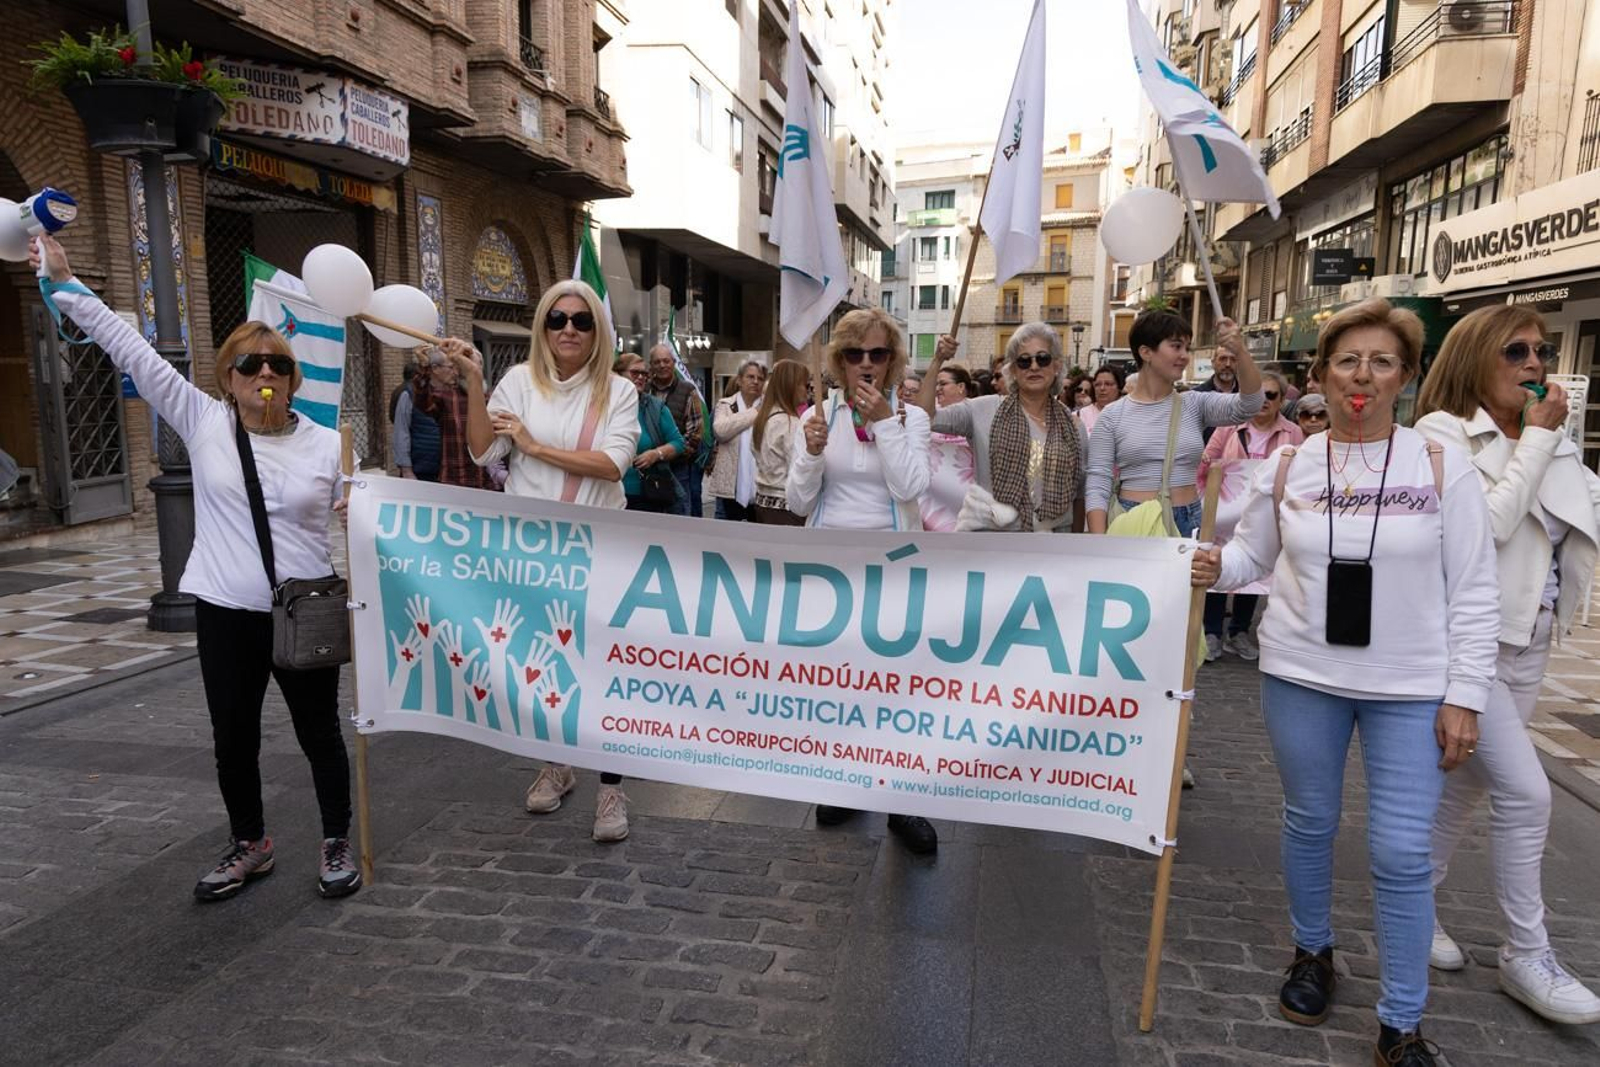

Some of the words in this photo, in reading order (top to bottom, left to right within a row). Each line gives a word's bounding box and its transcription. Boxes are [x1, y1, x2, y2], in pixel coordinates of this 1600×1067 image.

[350, 87, 389, 113] PELUQUERIA
[350, 102, 391, 128] CABALLEROS
[351, 119, 406, 157] TOLEDANO
[1515, 287, 1570, 304] MANGASVERDES
[375, 503, 593, 558] JUSTICIA
[420, 554, 442, 578] la
[452, 553, 590, 591] SANIDAD
[608, 543, 1151, 682] ANDÚJAR
[606, 643, 769, 680] ASOCIACIÓN
[777, 662, 901, 695] ANDÚJAR
[909, 674, 963, 702] POR
[970, 681, 1002, 708] LA
[1011, 686, 1139, 720] SANIDAD
[604, 676, 697, 709] APOYA
[705, 688, 726, 712] A
[735, 690, 867, 729] “JUSTICIA
[876, 706, 935, 737] POR
[942, 715, 977, 744] LA
[986, 721, 1143, 757] SANIDAD”
[601, 716, 674, 739] CONTRA
[679, 724, 701, 741] LA
[706, 727, 827, 757] CORRUPCIÓN
[832, 742, 931, 775] SANITARIA,
[937, 757, 1022, 782] POLÍTICA
[1029, 767, 1042, 782] Y
[1047, 769, 1138, 796] JUDICIAL
[602, 742, 873, 788] asociacion@justiciaporlasanidad.org
[891, 778, 1133, 822] www.justiciaporlasanidad.org
